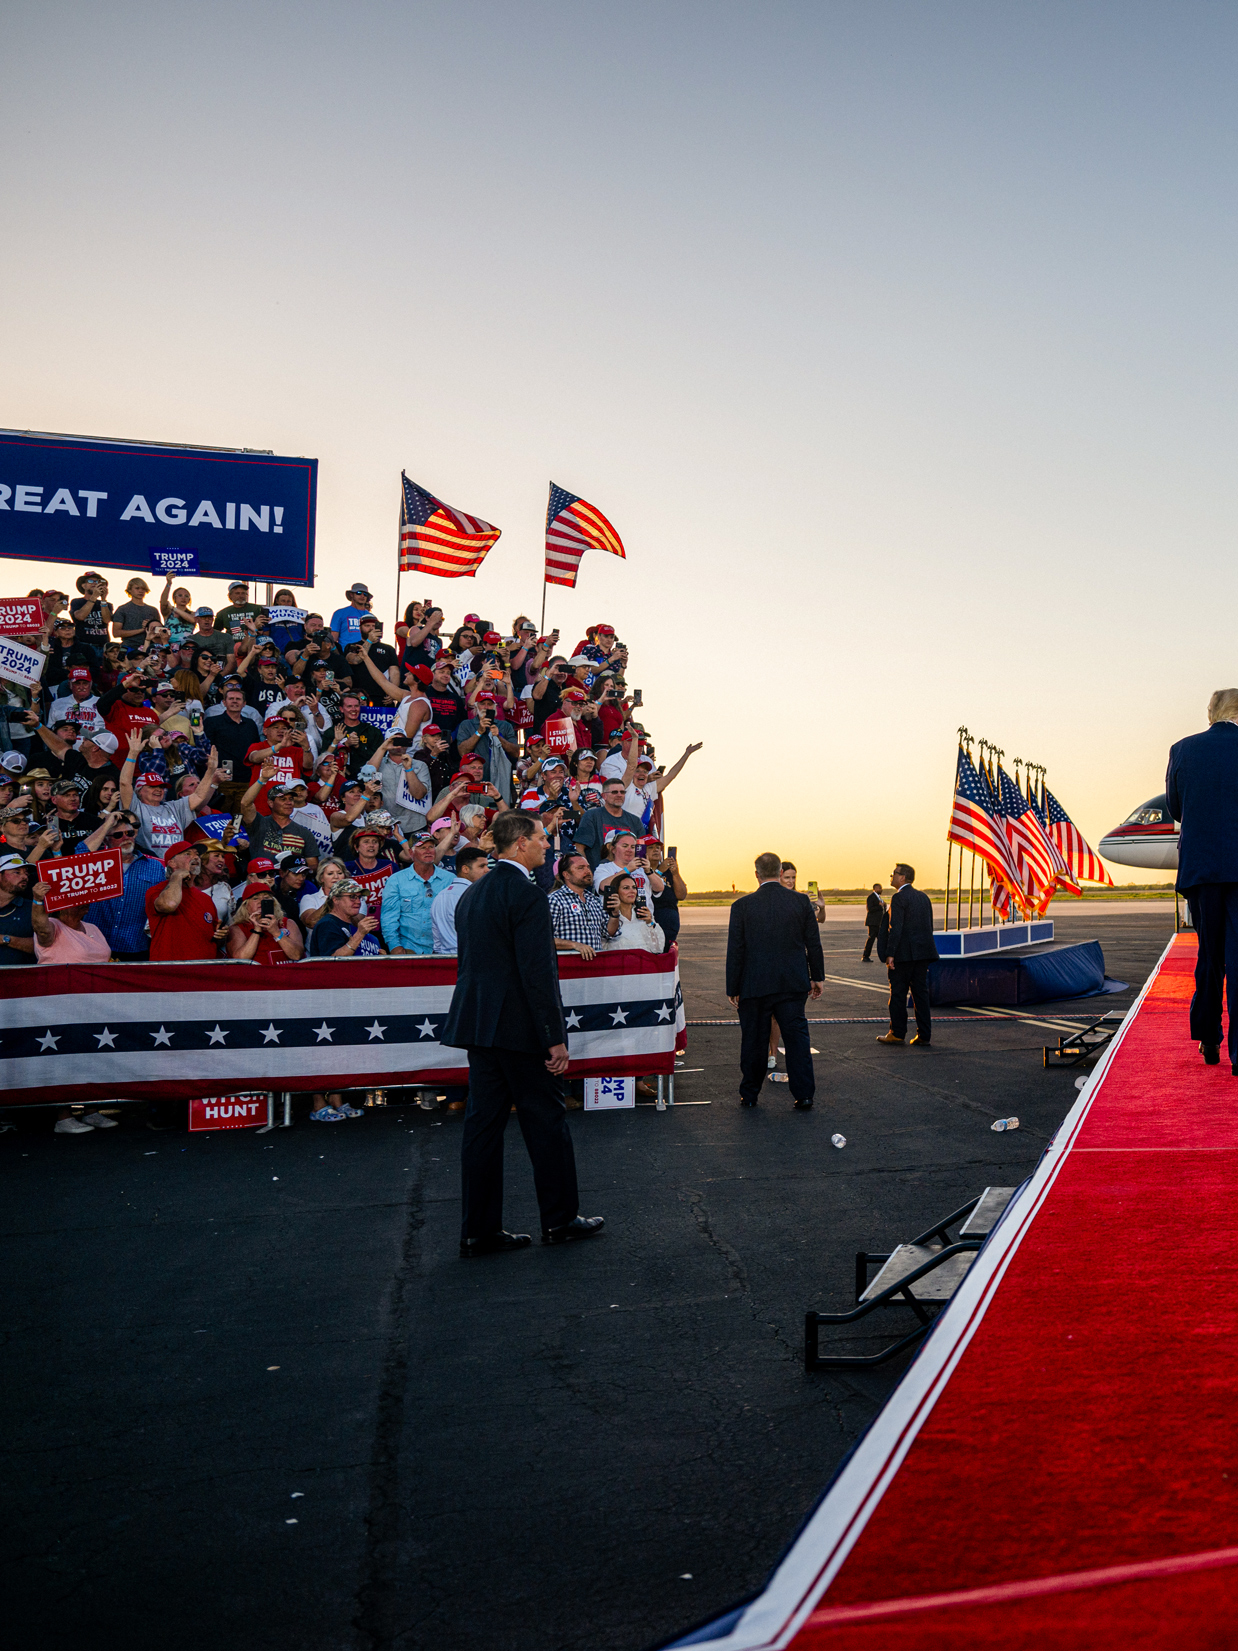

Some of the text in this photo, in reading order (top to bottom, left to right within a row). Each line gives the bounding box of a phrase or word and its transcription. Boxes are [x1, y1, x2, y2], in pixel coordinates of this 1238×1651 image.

[119, 494, 284, 534] AGAIN!
[154, 553, 194, 561] TRUMP
[160, 560, 189, 568] 2024
[0, 604, 37, 616] RUMP
[0, 614, 32, 624] 2024
[271, 613, 301, 621] HUNT
[0, 645, 39, 667] TRUMP
[1, 656, 32, 674] 2024
[360, 712, 394, 722] RUMP
[549, 734, 575, 746] TRUMP
[272, 756, 294, 767] TRA
[260, 771, 294, 783] AGA
[48, 859, 115, 882] TRUMP
[59, 873, 107, 893] 2024
[50, 894, 66, 902] TEXT
[66, 890, 89, 899] TRUMP
[360, 938, 380, 955] RUMP
[601, 1077, 612, 1095] 24
[613, 1079, 625, 1102] MP
[205, 1103, 260, 1119] HUNT
